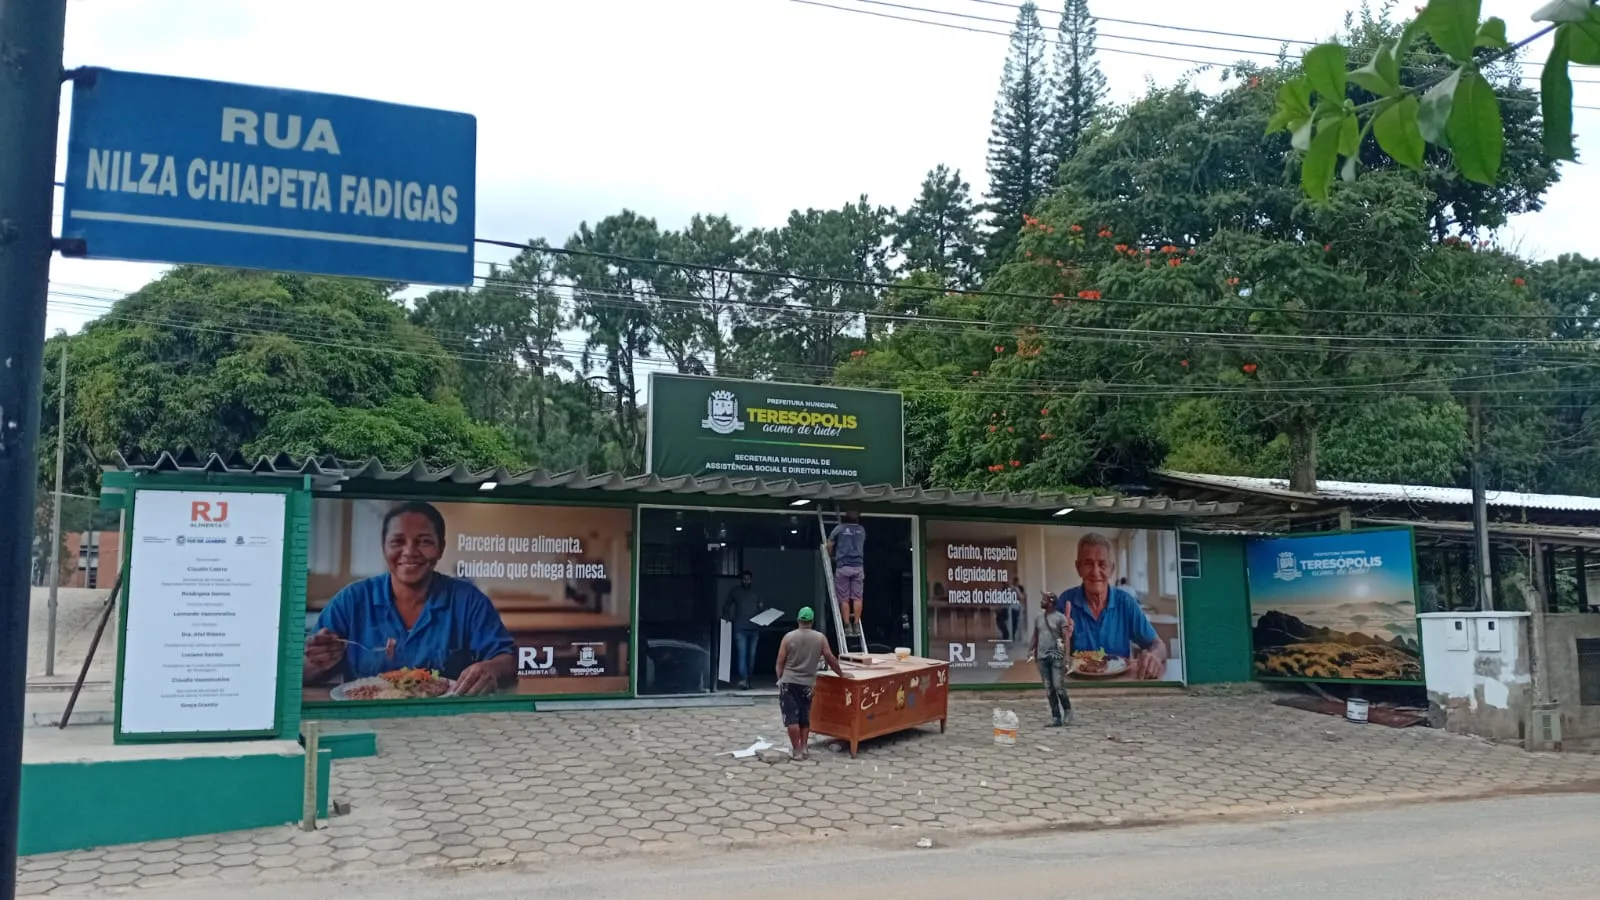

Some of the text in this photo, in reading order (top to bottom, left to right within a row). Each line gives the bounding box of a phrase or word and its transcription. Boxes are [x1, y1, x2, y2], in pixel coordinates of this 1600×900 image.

[221, 107, 341, 154] RUA
[86, 148, 458, 224] NILZA CHIAPETA FADIGAS
[767, 398, 838, 409] PREFEITURA MUNICIPAL
[746, 408, 857, 429] TERESÓPOLIS
[763, 423, 842, 437] acima de tudo!
[705, 461, 754, 471] ASSISTÊNCIA
[755, 465, 781, 473] SOCIAL
[788, 467, 820, 475] DIREITOS
[822, 469, 857, 477] HUMANOS
[735, 454, 780, 464] SECRETARIA
[781, 456, 820, 466] MUNICIPAL
[191, 500, 228, 522] RJ
[458, 534, 583, 554] Parceria que alimenta.
[948, 544, 1017, 562] Carinho, respeito
[457, 560, 607, 580] Cuidado que chega à mesa.
[1300, 555, 1382, 570] TERESÓPOLIS
[948, 566, 1008, 583] e dignidade na
[949, 588, 1020, 604] mesa do cidadão.
[518, 647, 554, 669] RJ
[949, 643, 975, 662] RJ
